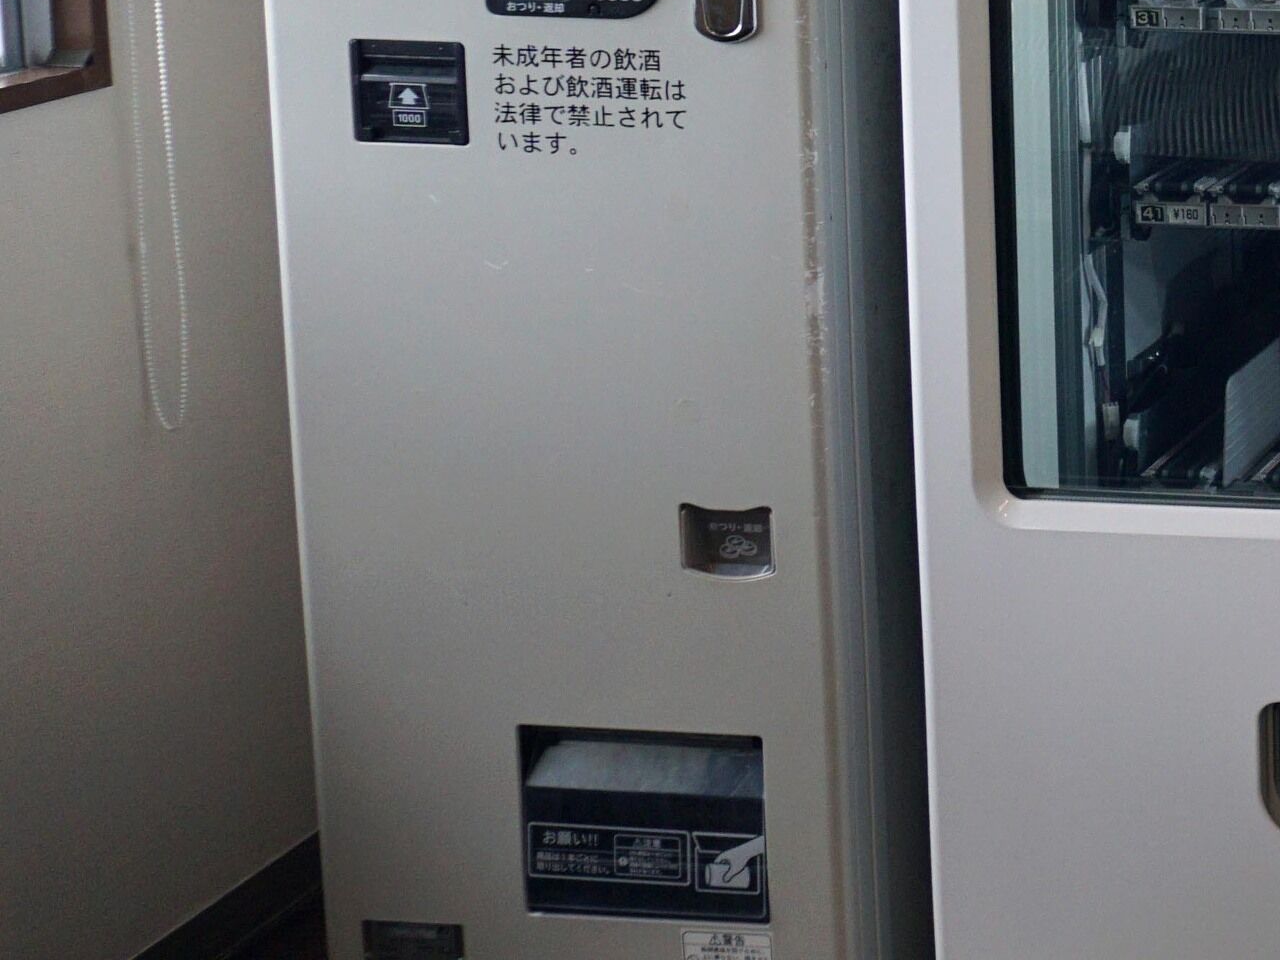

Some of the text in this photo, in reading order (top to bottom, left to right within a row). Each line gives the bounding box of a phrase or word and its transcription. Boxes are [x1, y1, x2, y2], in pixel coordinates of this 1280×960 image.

[1137, 11, 1159, 25] 31
[493, 44, 661, 72] 未成年者の飲酒
[494, 74, 687, 101] および飲酒運転は
[397, 113, 421, 124] 1000
[494, 102, 687, 130] 法律で禁止されて
[498, 131, 577, 156] います。
[1142, 206, 1163, 220] 41
